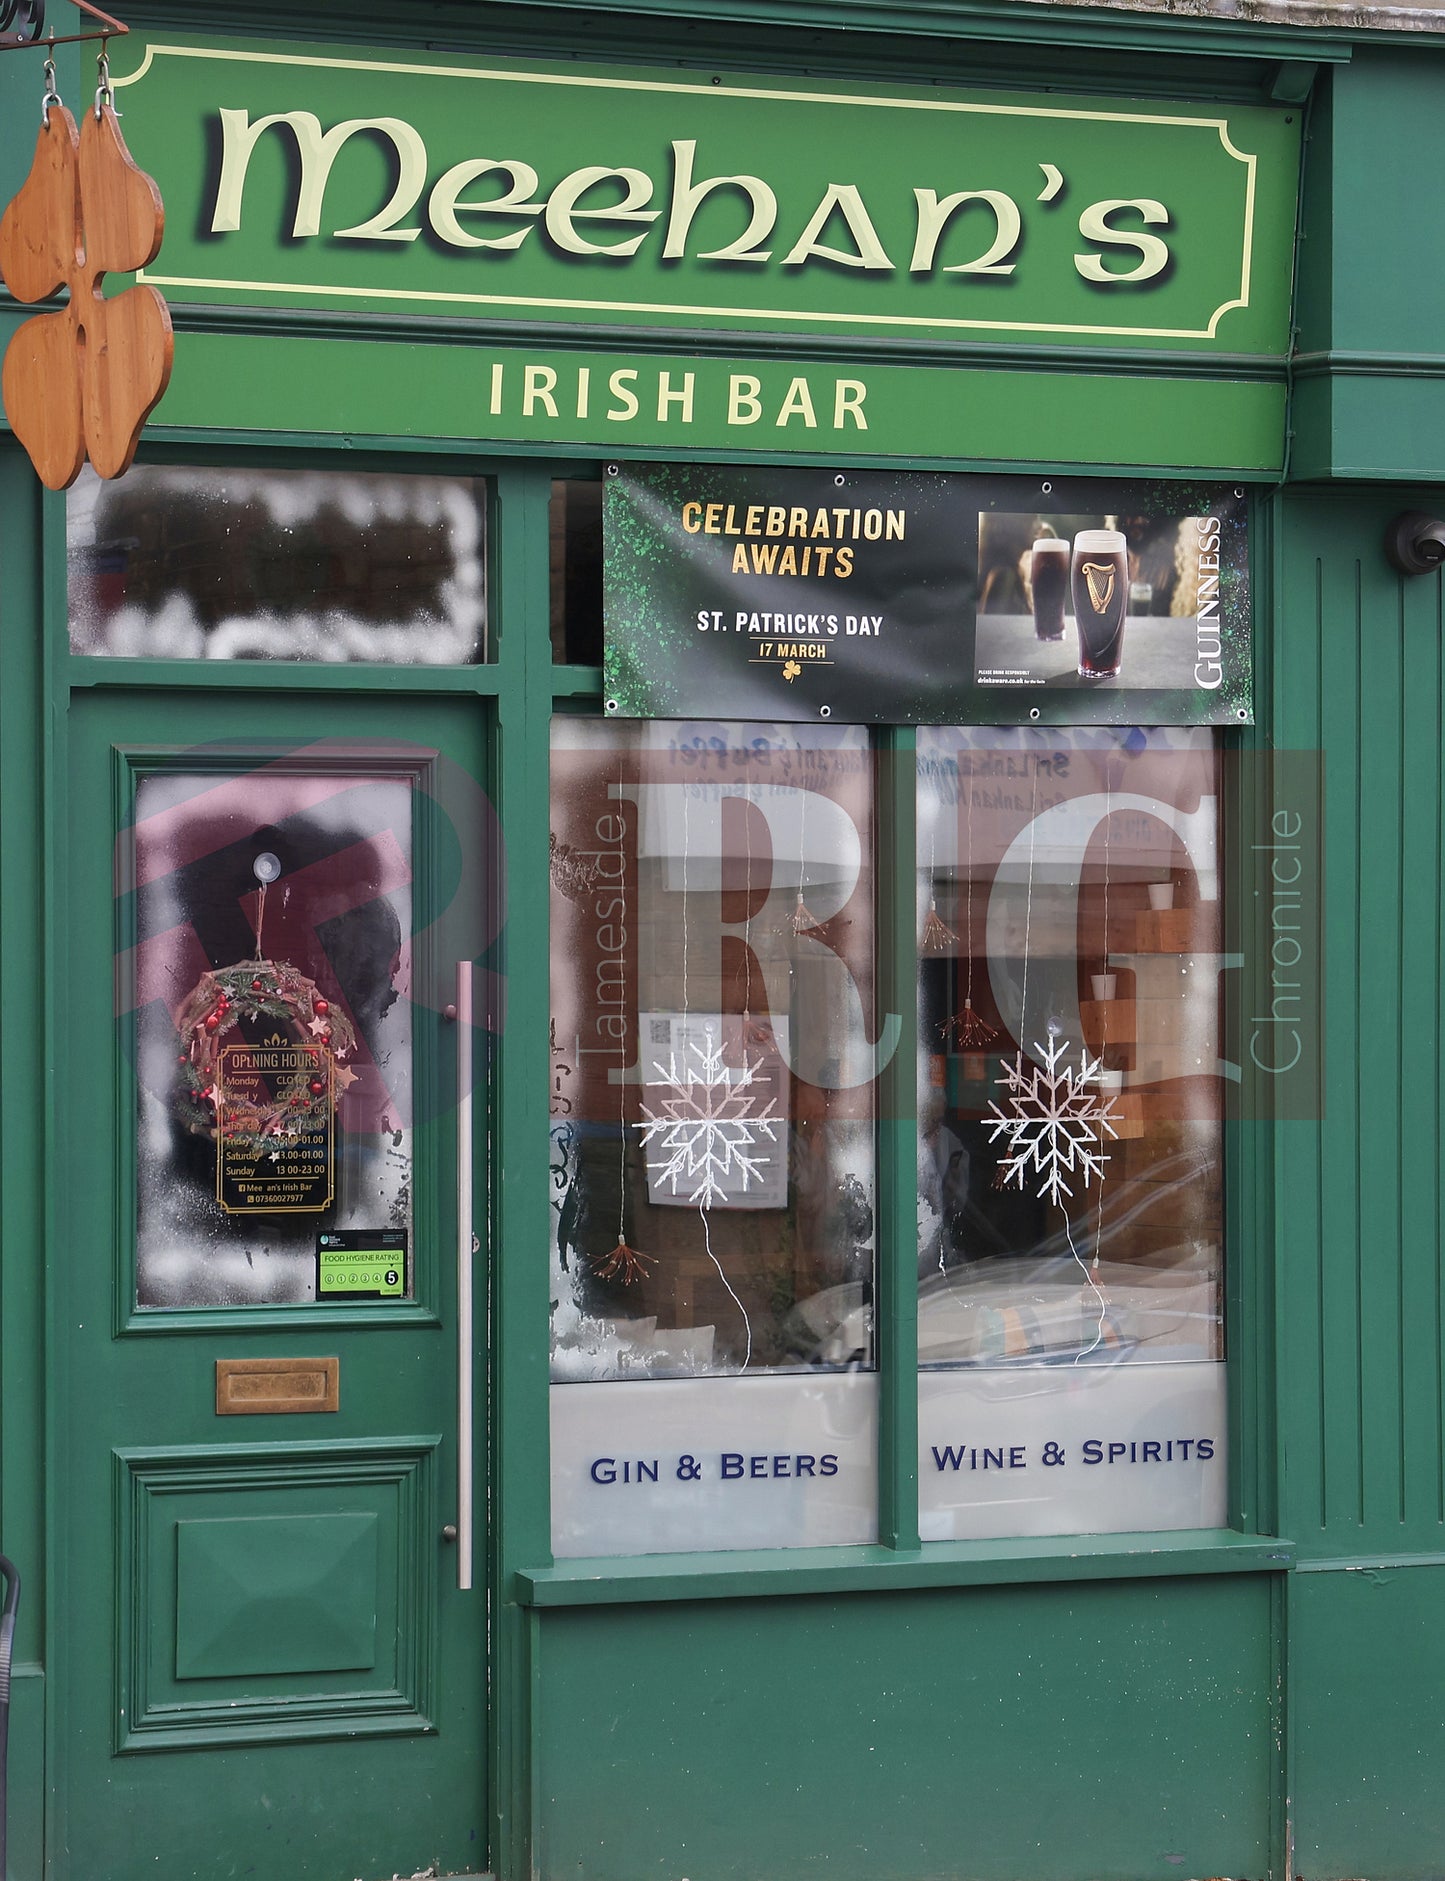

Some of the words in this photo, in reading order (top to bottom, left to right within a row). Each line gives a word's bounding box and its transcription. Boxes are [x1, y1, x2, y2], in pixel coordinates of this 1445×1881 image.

[489, 362, 696, 424] IRISH
[726, 373, 869, 431] BAR
[681, 501, 906, 541] CELEBRATION
[731, 543, 855, 579] AWAITS
[696, 610, 727, 632] ST.
[735, 612, 839, 635] PATRICK'S
[845, 614, 883, 637] DAY
[759, 642, 771, 657] 17
[777, 643, 827, 659] MARCH
[281, 1053, 319, 1068] HOURS
[226, 1076, 259, 1087] Monday
[226, 1091, 258, 1102] Tuesdy
[226, 1151, 261, 1162] Saturday
[226, 1166, 256, 1177] Sunday
[246, 1183, 281, 1192] Meean's
[282, 1182, 299, 1192] Irish
[300, 1182, 313, 1191] Bar
[324, 1255, 345, 1263] FOOD
[375, 1253, 400, 1261] RATING
[387, 1271, 396, 1284] 5
[1041, 1441, 1066, 1467] &
[675, 1456, 703, 1481] &
